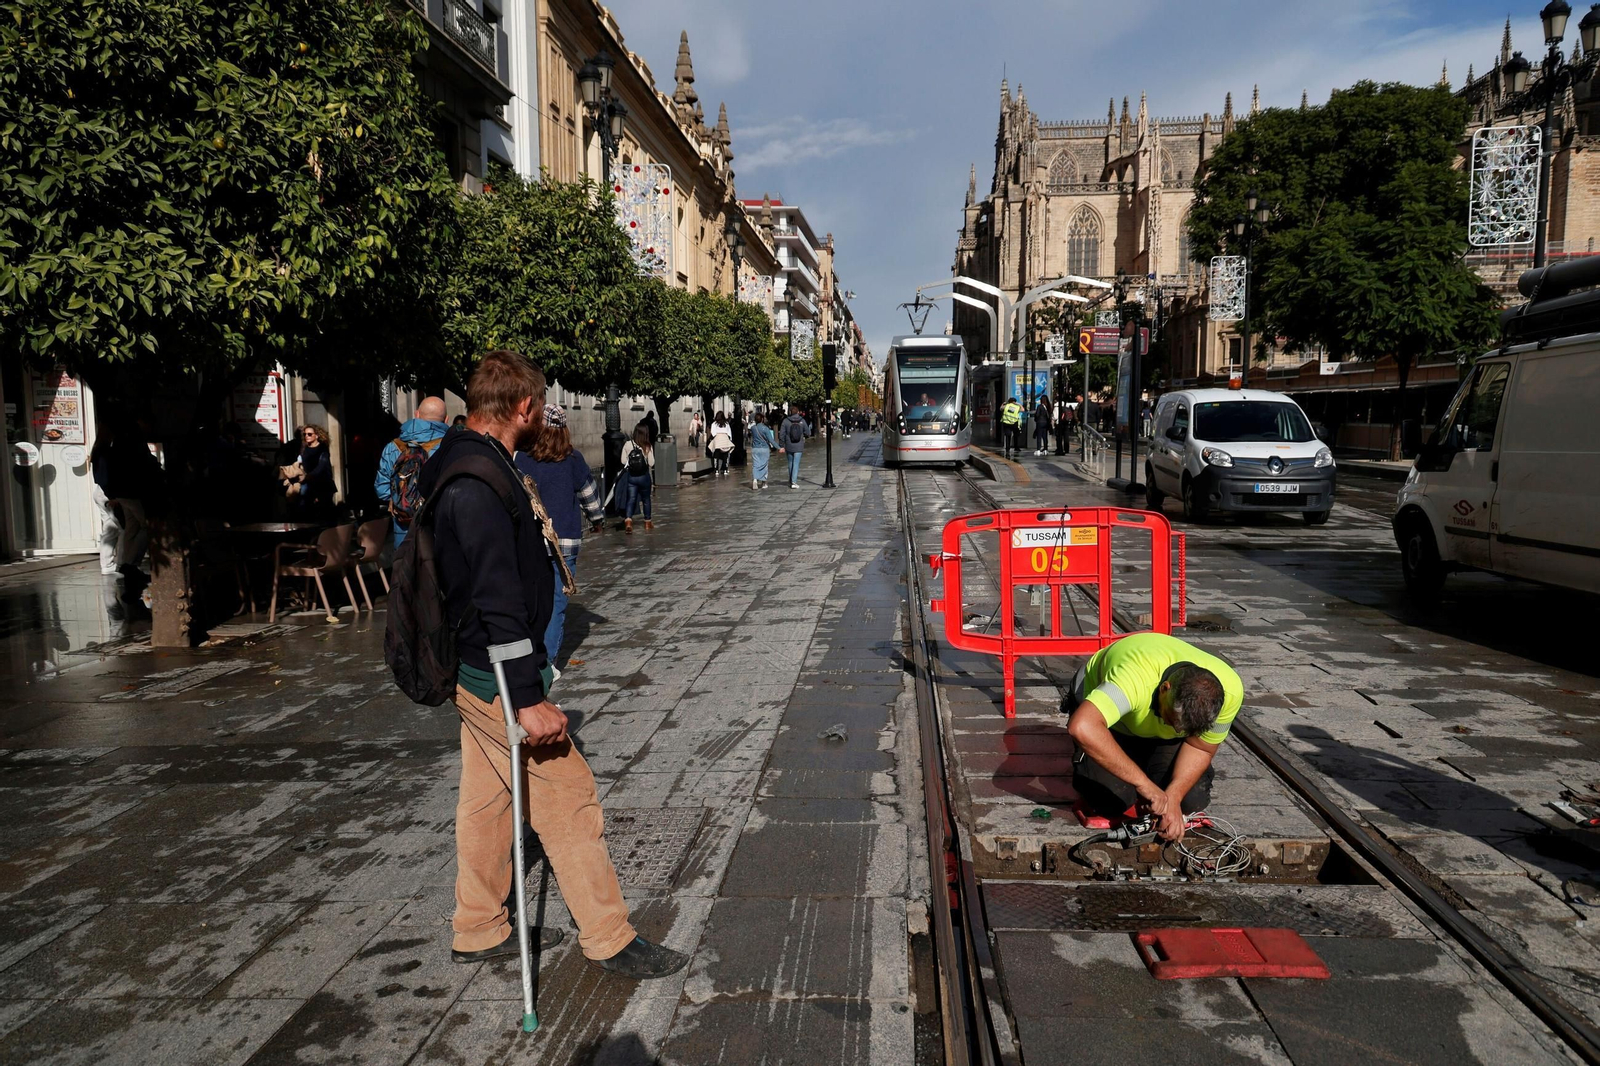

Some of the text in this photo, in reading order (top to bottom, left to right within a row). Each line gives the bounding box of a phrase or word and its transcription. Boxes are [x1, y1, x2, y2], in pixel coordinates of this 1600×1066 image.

[1260, 484, 1281, 493] 0539
[1452, 516, 1476, 527] TUSSAM
[1025, 531, 1067, 541] TUSSAM
[1031, 547, 1069, 573] 05
